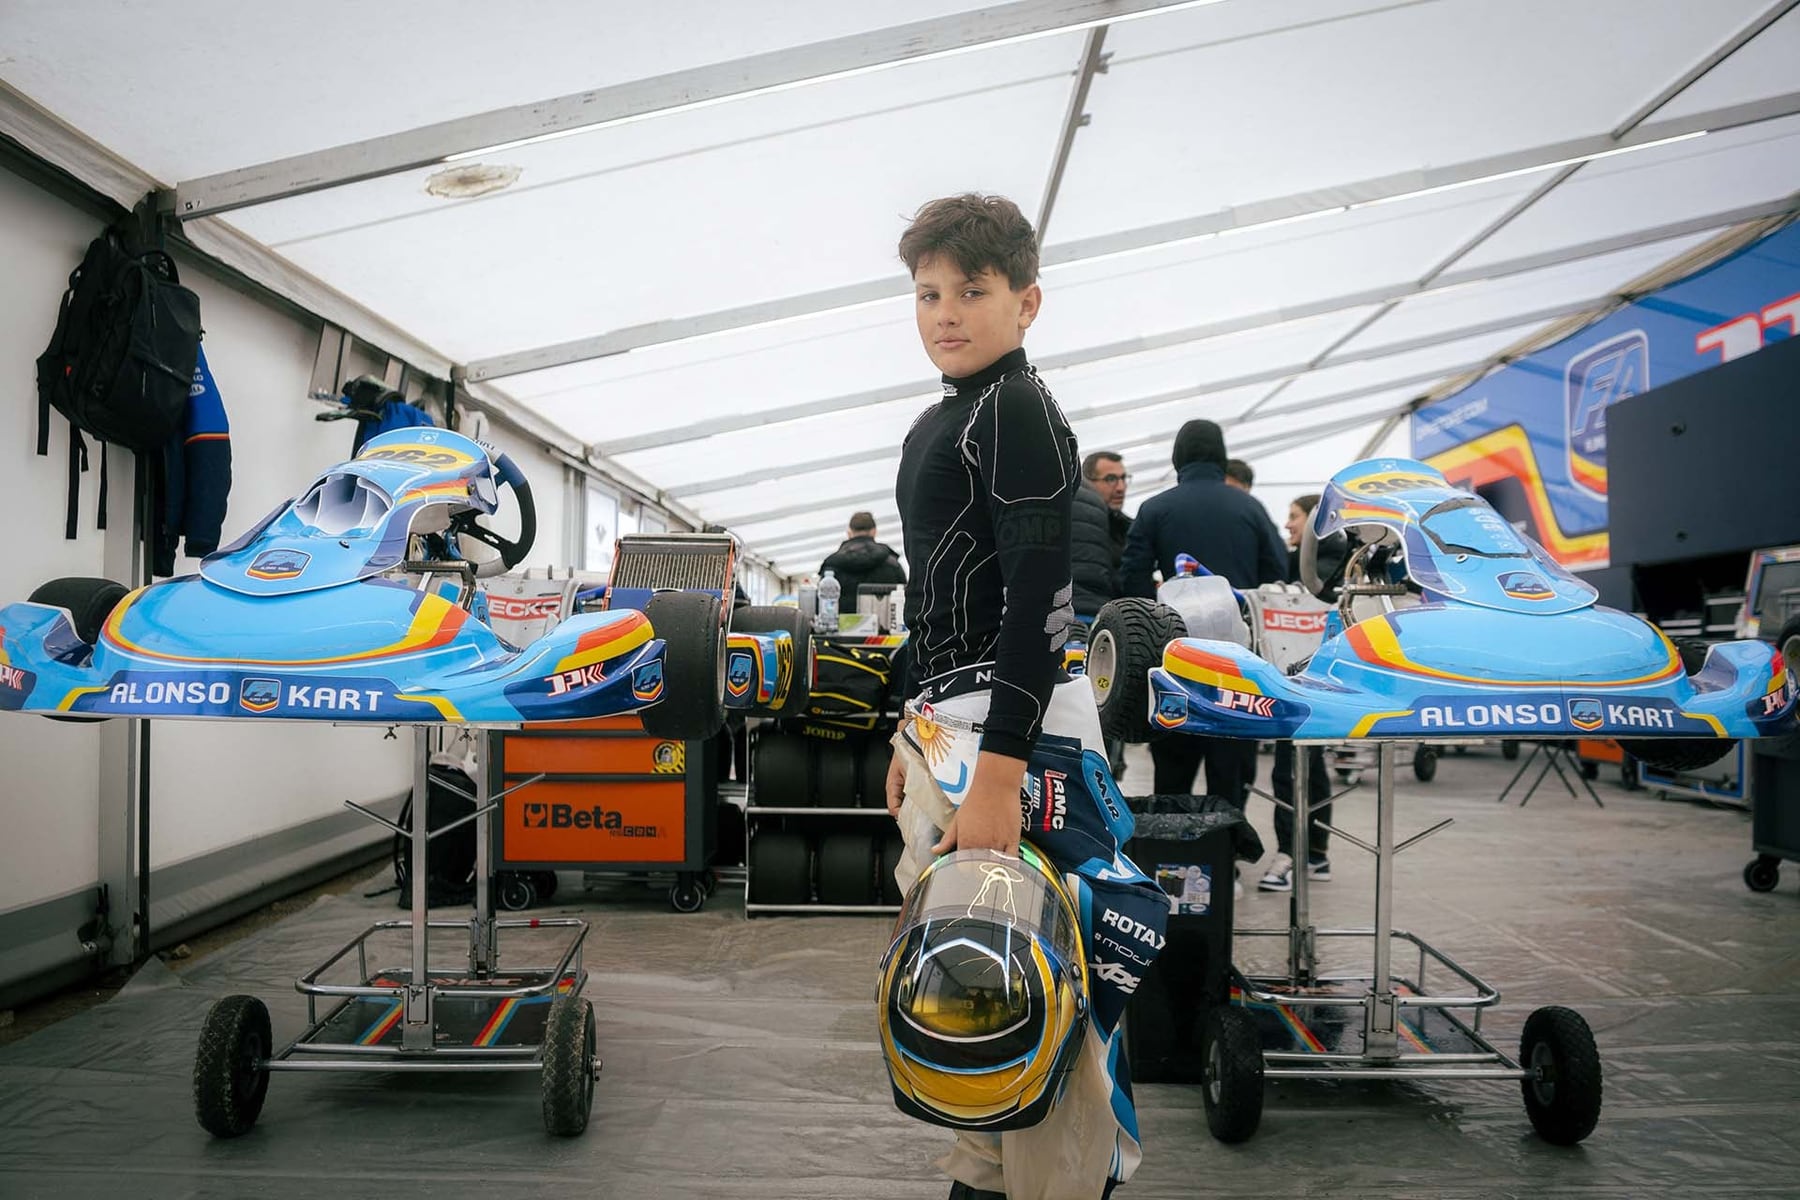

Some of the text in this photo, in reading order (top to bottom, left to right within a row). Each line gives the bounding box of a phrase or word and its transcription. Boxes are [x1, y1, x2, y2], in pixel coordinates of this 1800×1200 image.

[487, 599, 561, 617] ECKO
[1265, 612, 1328, 631] JECK
[109, 681, 384, 712] ALONSO KART
[1420, 703, 1674, 728] ALONSO KART
[551, 803, 623, 830] Beta
[1051, 779, 1067, 830] RMC
